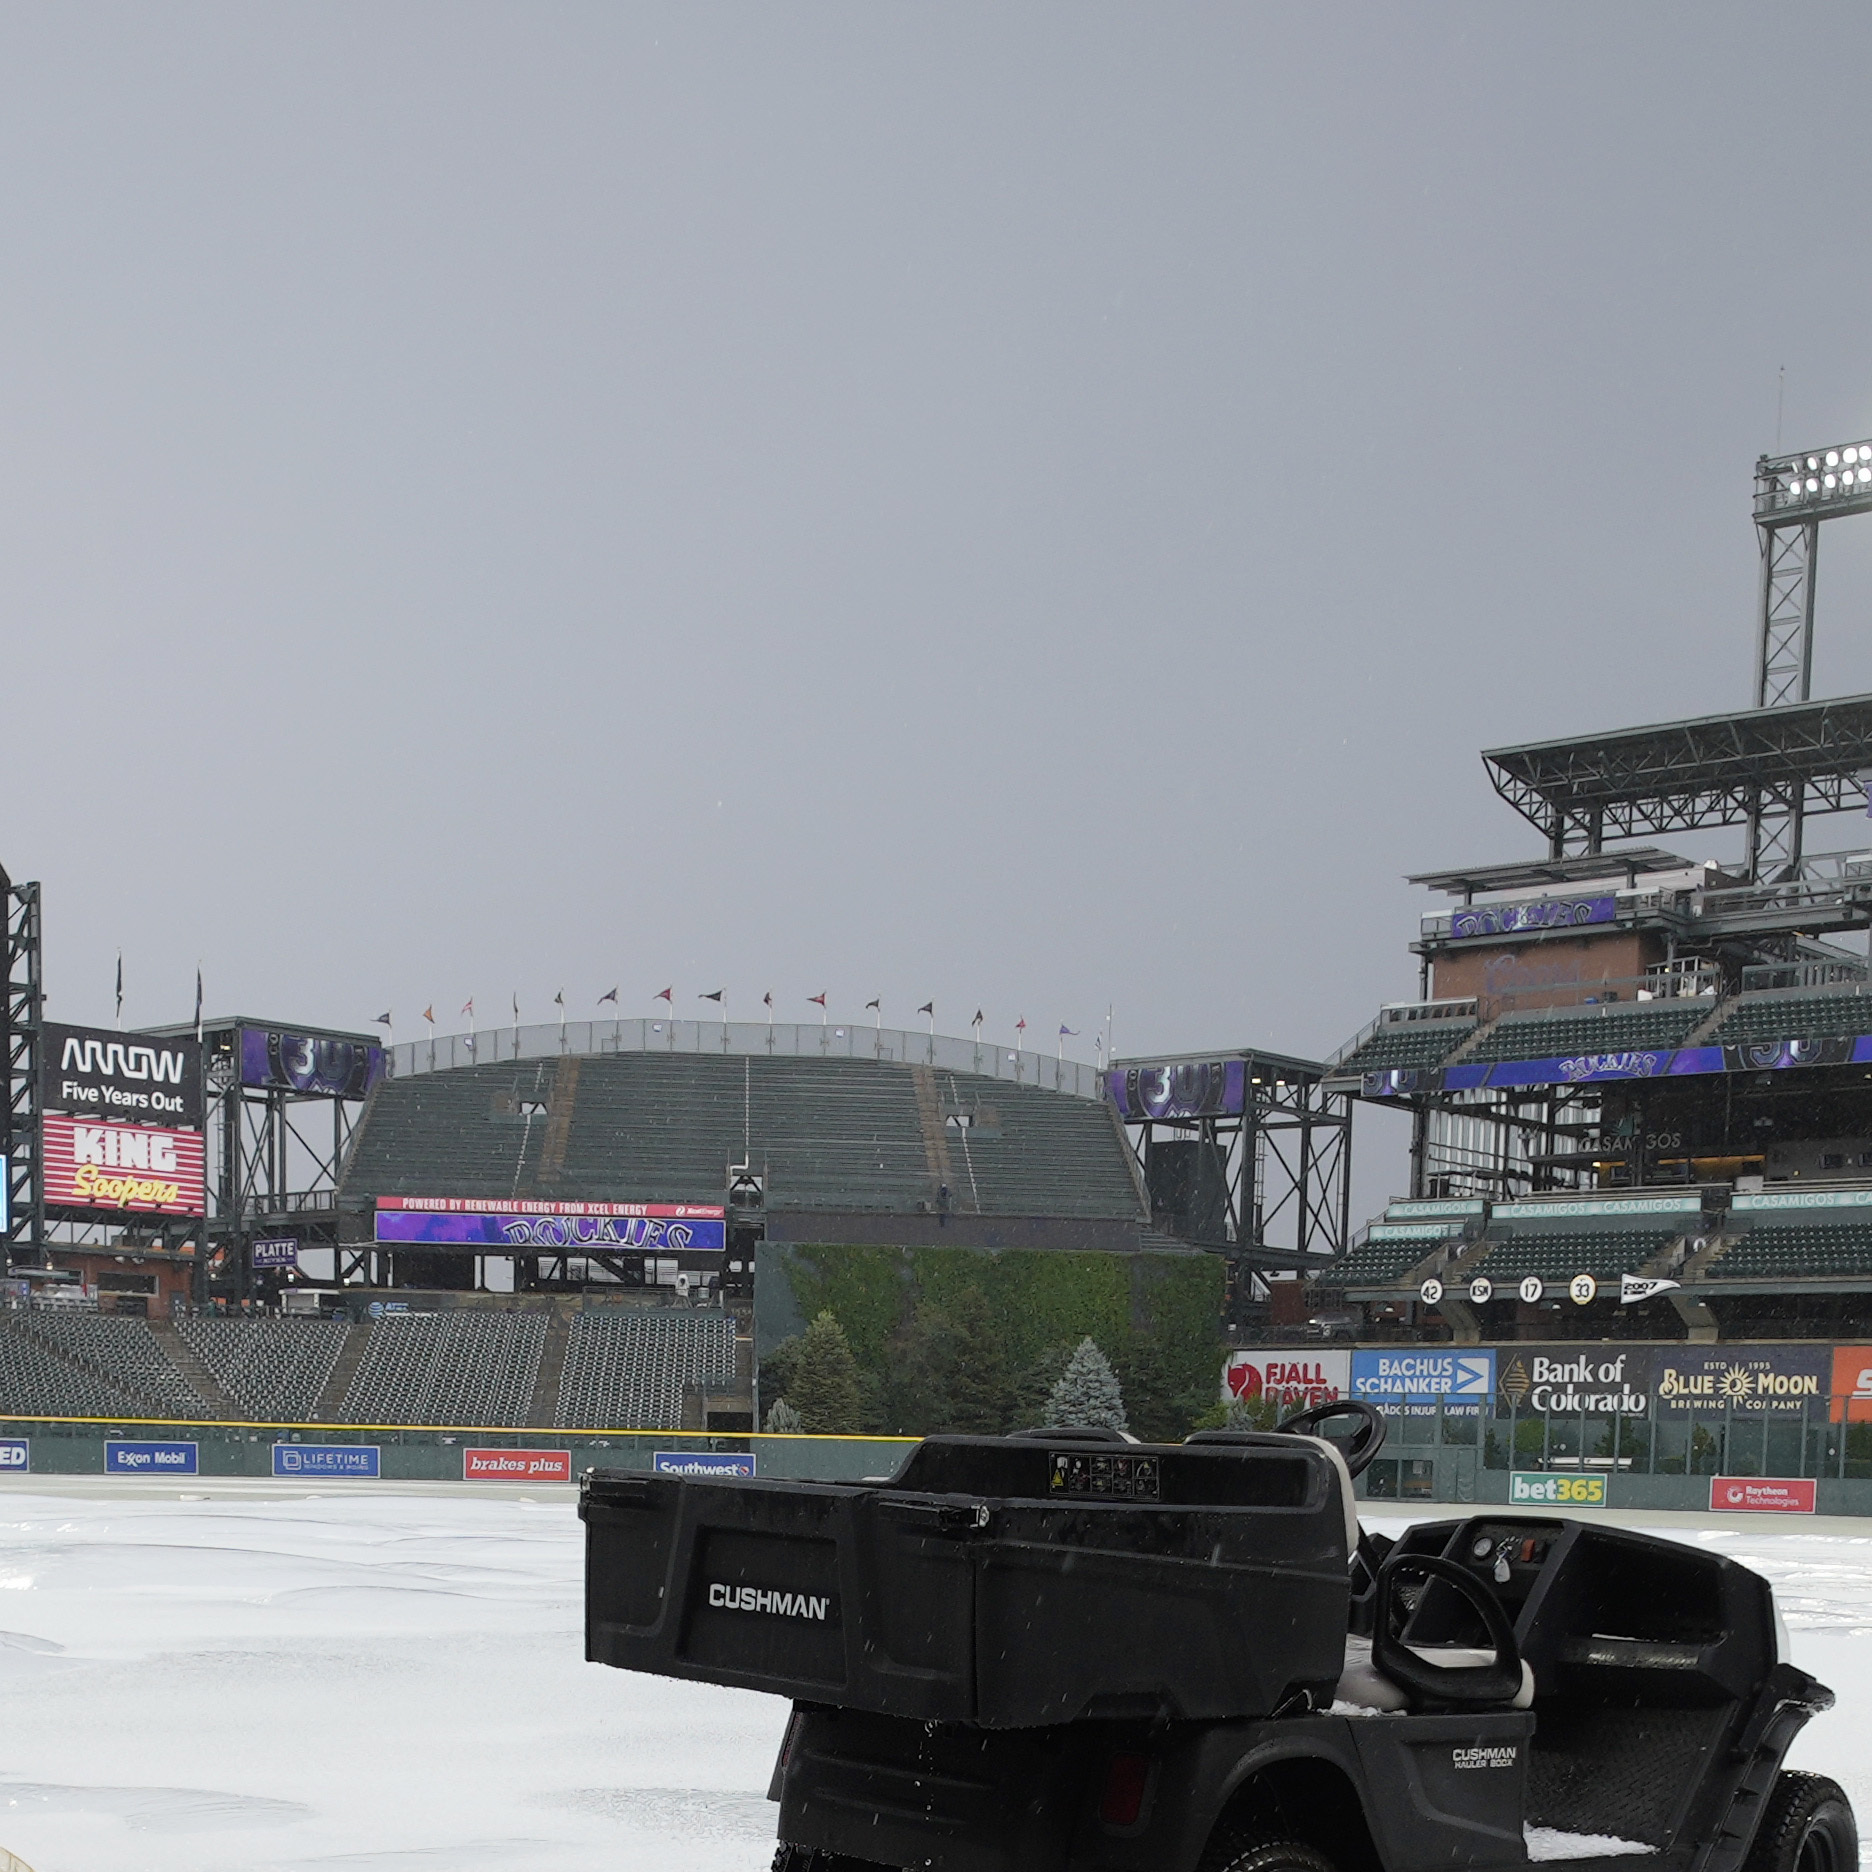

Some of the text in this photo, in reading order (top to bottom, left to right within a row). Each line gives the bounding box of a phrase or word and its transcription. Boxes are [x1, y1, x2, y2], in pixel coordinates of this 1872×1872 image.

[62, 1081, 184, 1112] Five Years Out
[74, 1127, 177, 1172] KING
[72, 1164, 179, 1208] Soopers
[402, 1198, 647, 1217] POWERED BY RENEWABLE ENERGY FROM XCEL ENERGY
[1404, 1203, 1468, 1215] CASAMIGOS
[1511, 1199, 1681, 1216] CASAMIGOS CASAMIGOS
[1752, 1192, 1834, 1209] CASAMIGOS
[255, 1242, 295, 1257] PLATTE
[1423, 1286, 1437, 1299] 42
[1524, 1283, 1537, 1298] 17
[1576, 1283, 1590, 1298] 33
[1266, 1361, 1327, 1384] FJÄLL
[1379, 1358, 1453, 1376] BACHUS
[1533, 1354, 1626, 1383] Bank of
[1356, 1377, 1452, 1394] SCHANKER
[1659, 1369, 1818, 1399] BLUE MOON
[1532, 1384, 1647, 1412] Colorado
[154, 1450, 186, 1465] Mobil
[303, 1453, 369, 1466] LIFETIME
[470, 1456, 564, 1475] brakes plus
[659, 1461, 738, 1476] Southwest
[1514, 1477, 1602, 1501] bet365
[1746, 1485, 1788, 1497] Raytheon
[1746, 1496, 1799, 1507] Technologies
[709, 1583, 829, 1620] CUSHMAN
[1453, 1747, 1517, 1761] CUSHMAN
[1455, 1760, 1486, 1769] HAULER
